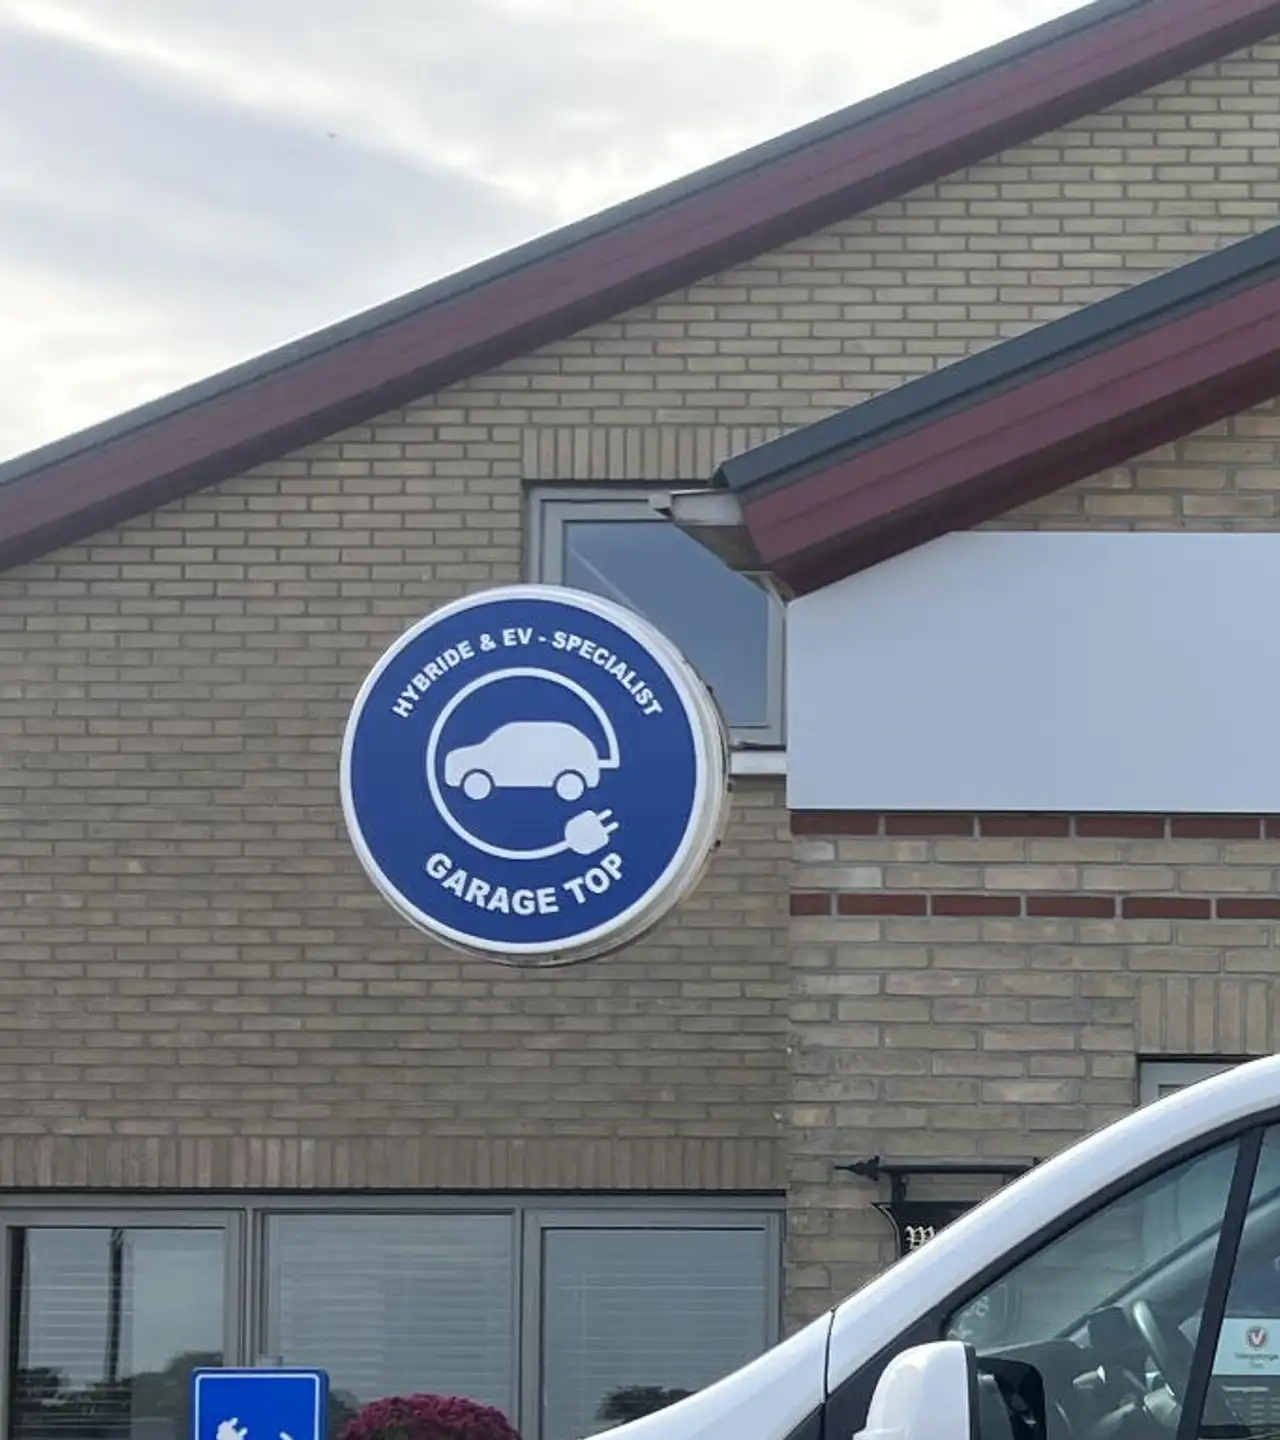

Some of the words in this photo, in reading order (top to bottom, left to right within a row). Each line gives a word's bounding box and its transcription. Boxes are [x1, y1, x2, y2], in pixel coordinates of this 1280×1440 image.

[392, 640, 475, 718] HYBRIDE
[479, 633, 498, 652] &
[502, 627, 534, 648] EV
[551, 631, 663, 717] SPECIALIST
[424, 852, 560, 915] GARAGE
[562, 852, 624, 904] TOP
